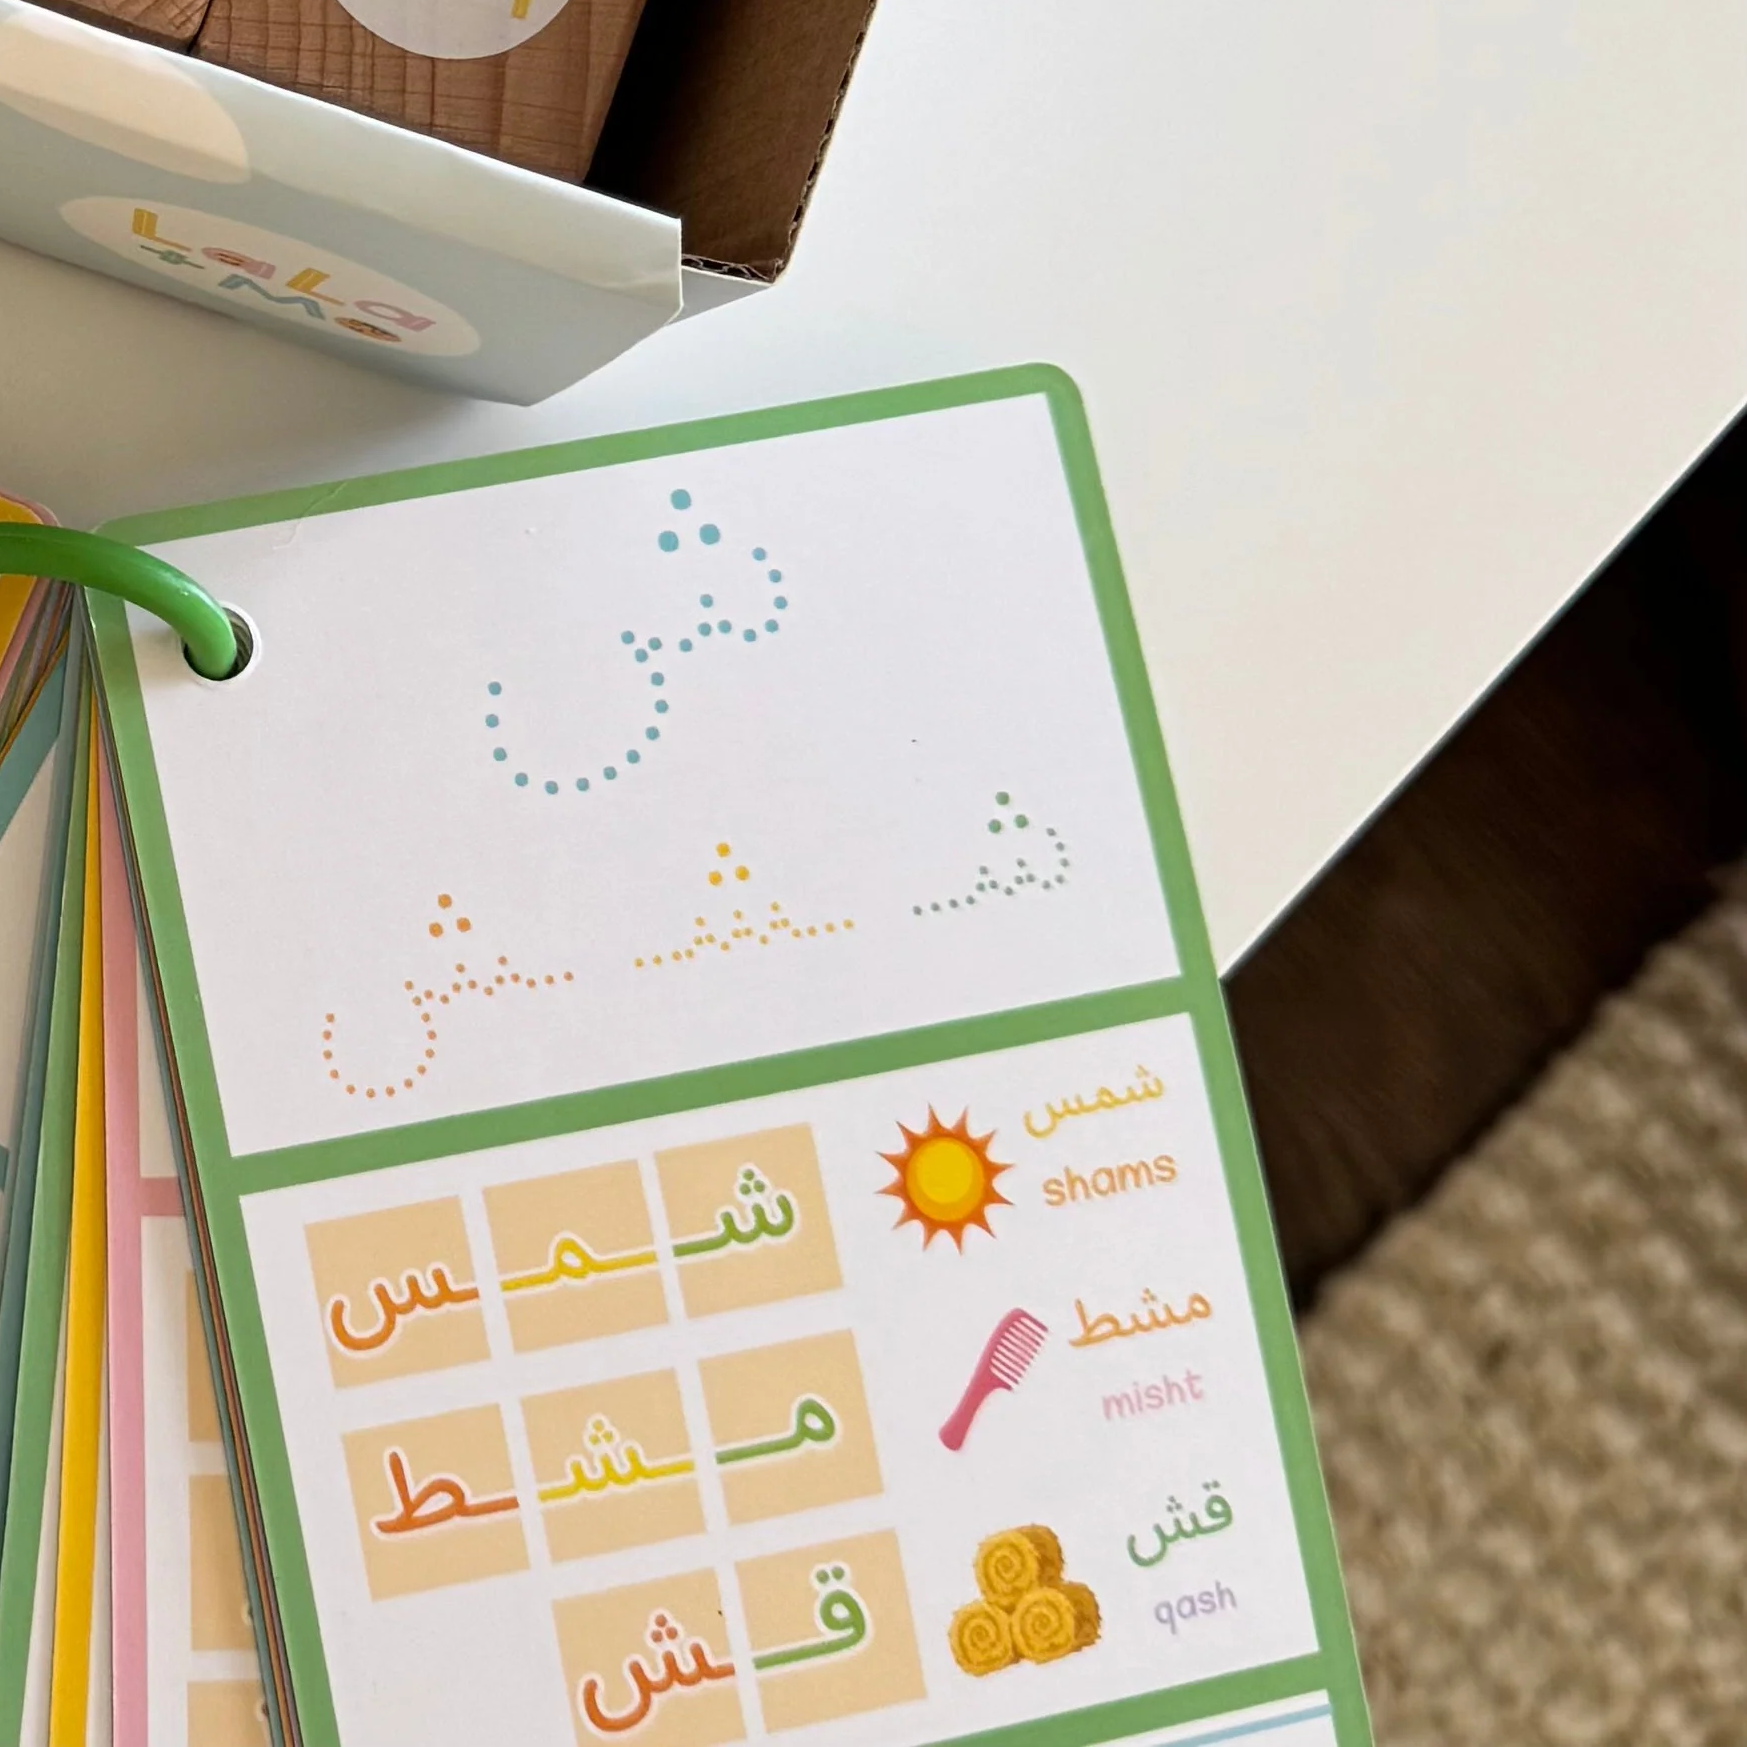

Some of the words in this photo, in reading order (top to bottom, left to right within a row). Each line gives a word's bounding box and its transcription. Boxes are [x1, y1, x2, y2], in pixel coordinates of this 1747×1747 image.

[1024, 1064, 1164, 1139] شمس
[1041, 1154, 1178, 1206] shams
[1068, 1287, 1213, 1348] مشط
[1101, 1369, 1205, 1421] misht
[1127, 1480, 1233, 1568] قش
[1155, 1581, 1237, 1635] qash
